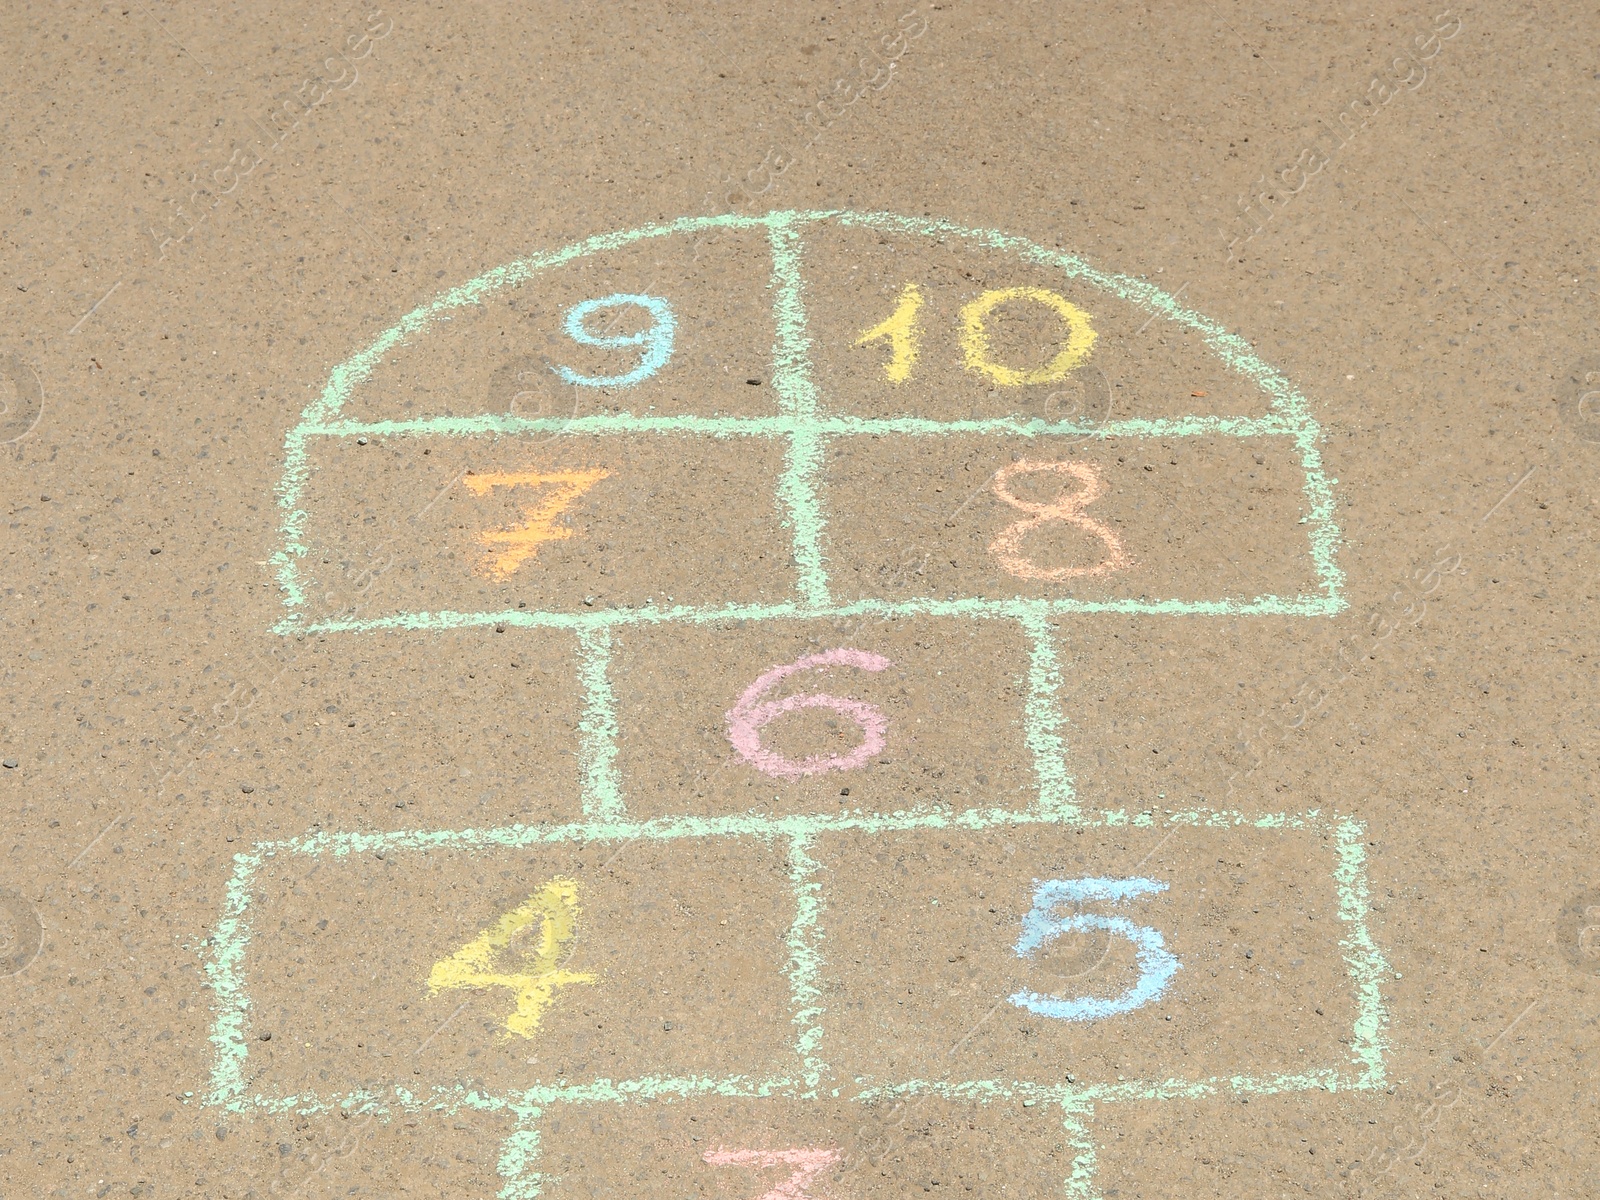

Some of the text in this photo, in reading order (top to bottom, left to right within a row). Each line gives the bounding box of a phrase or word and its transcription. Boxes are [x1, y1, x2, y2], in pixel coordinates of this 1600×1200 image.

[549, 293, 678, 387] 9
[854, 284, 1098, 387] 10
[460, 467, 609, 582] 7
[989, 457, 1133, 582] 8
[724, 646, 892, 779] 6
[425, 875, 596, 1041] 4
[1009, 875, 1183, 1021] 5
